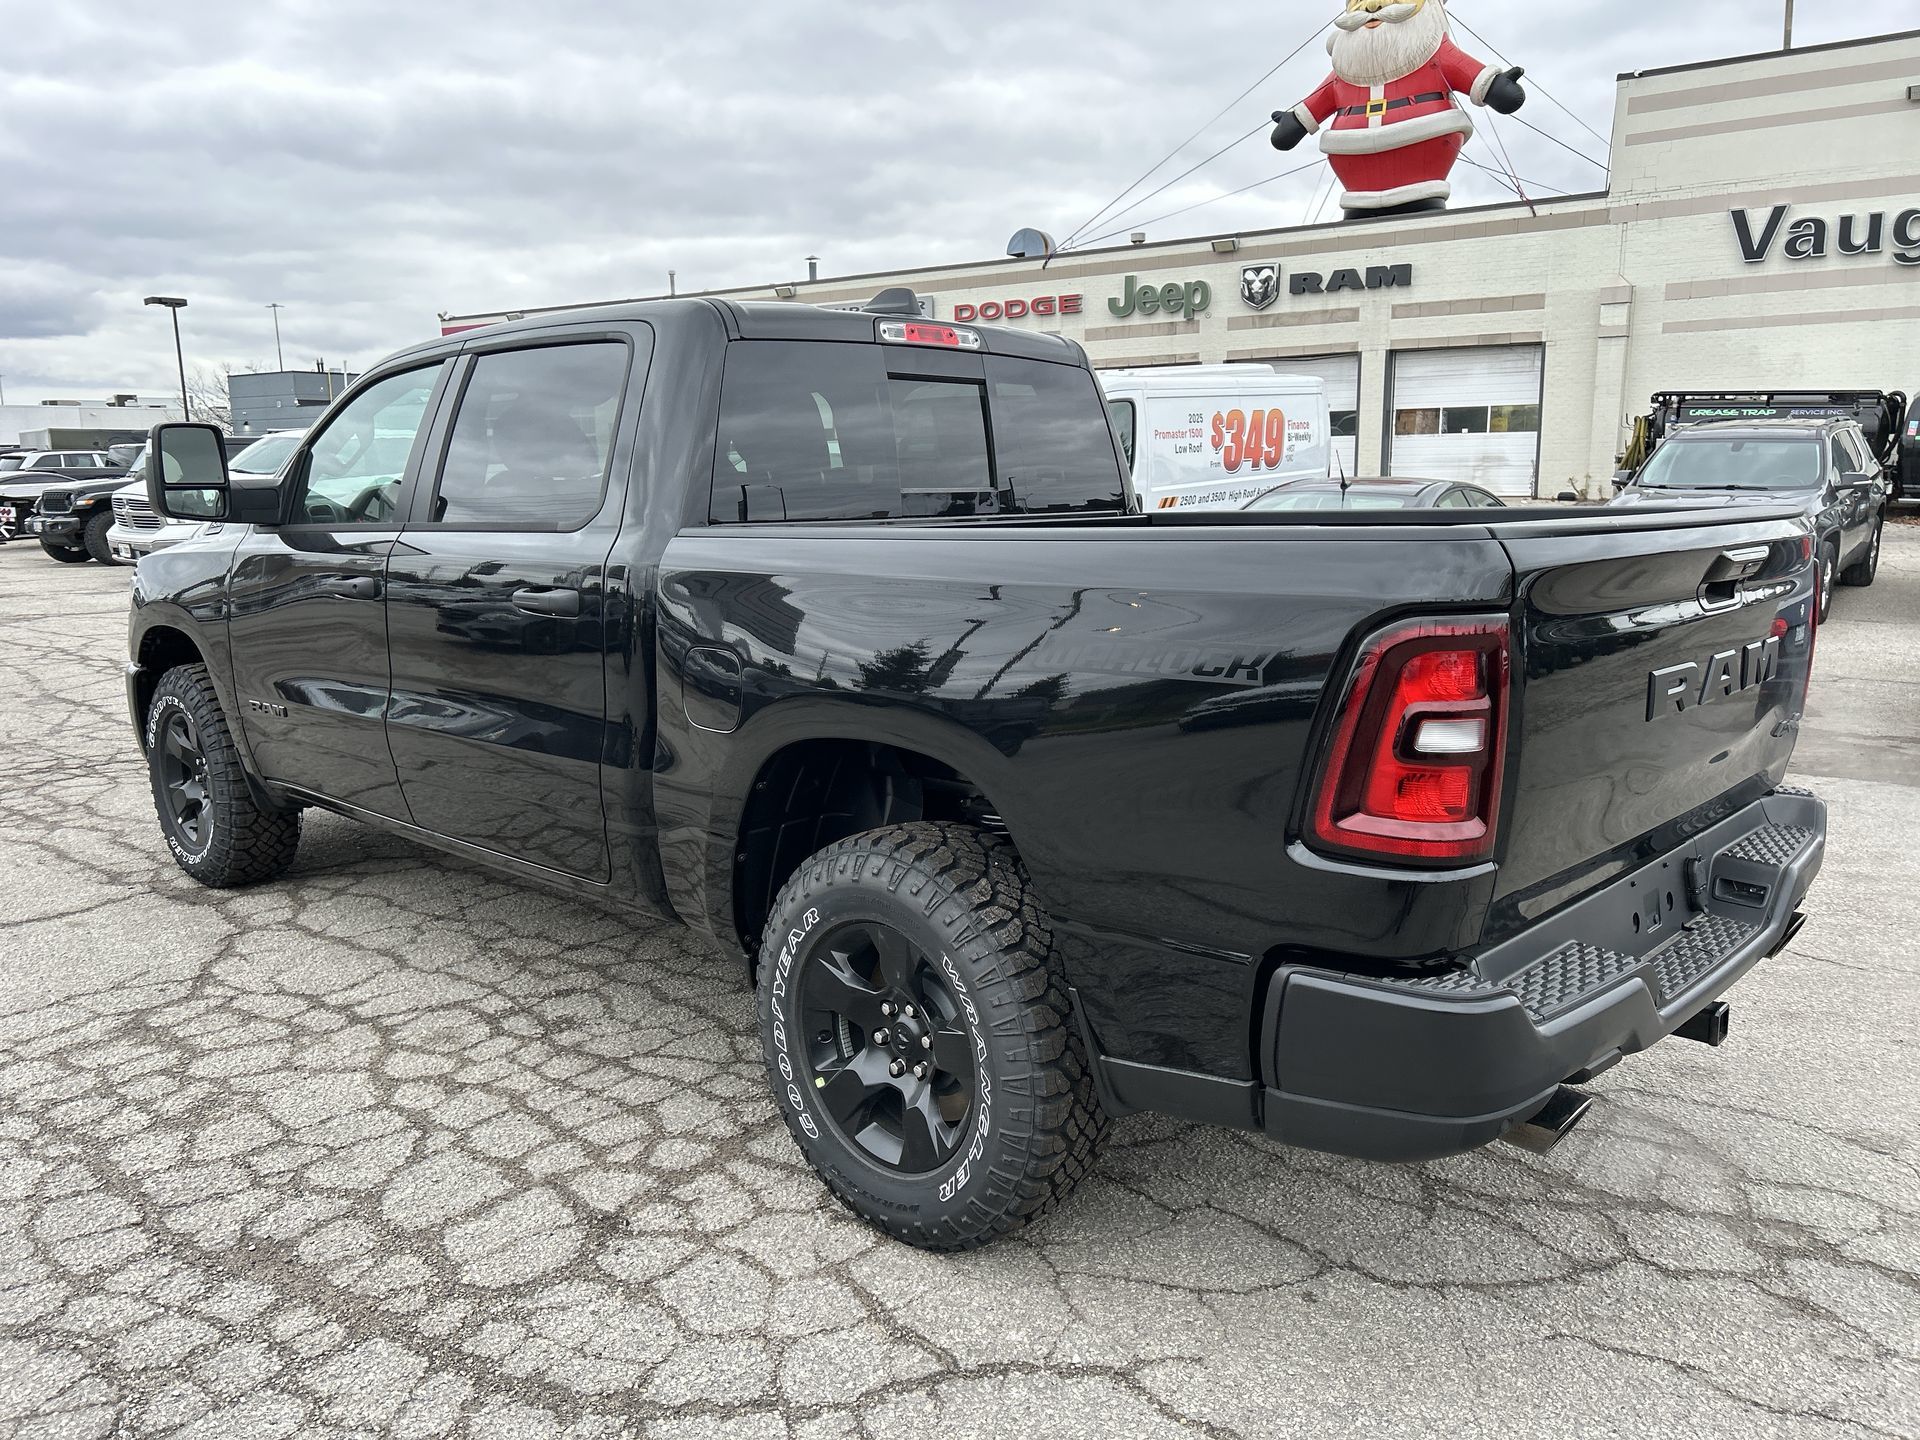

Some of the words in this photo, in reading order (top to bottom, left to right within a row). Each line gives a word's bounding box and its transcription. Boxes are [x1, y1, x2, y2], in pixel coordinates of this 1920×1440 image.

[1289, 263, 1412, 295] RAM
[1107, 275, 1212, 320] Jeep
[954, 294, 1083, 323] DODGE
[1188, 413, 1204, 424] 2025
[1287, 419, 1310, 431] Finance
[1154, 429, 1187, 440] Promaster
[1188, 428, 1203, 438] 1500
[1211, 408, 1286, 475] $349
[1287, 432, 1312, 443] Bi-Weekly
[1174, 443, 1187, 454] Low
[1188, 442, 1203, 454] Roof
[1210, 460, 1222, 468] From
[1180, 494, 1197, 506] 2500
[1198, 493, 1210, 504] and
[1211, 491, 1227, 503] 3500
[1228, 489, 1242, 502] High
[1243, 487, 1256, 498] Roof
[1645, 635, 1780, 722] RAM
[249, 699, 289, 718] RAM
[772, 907, 821, 1140] GOODYEAR
[938, 953, 992, 1203] WRANGLER
